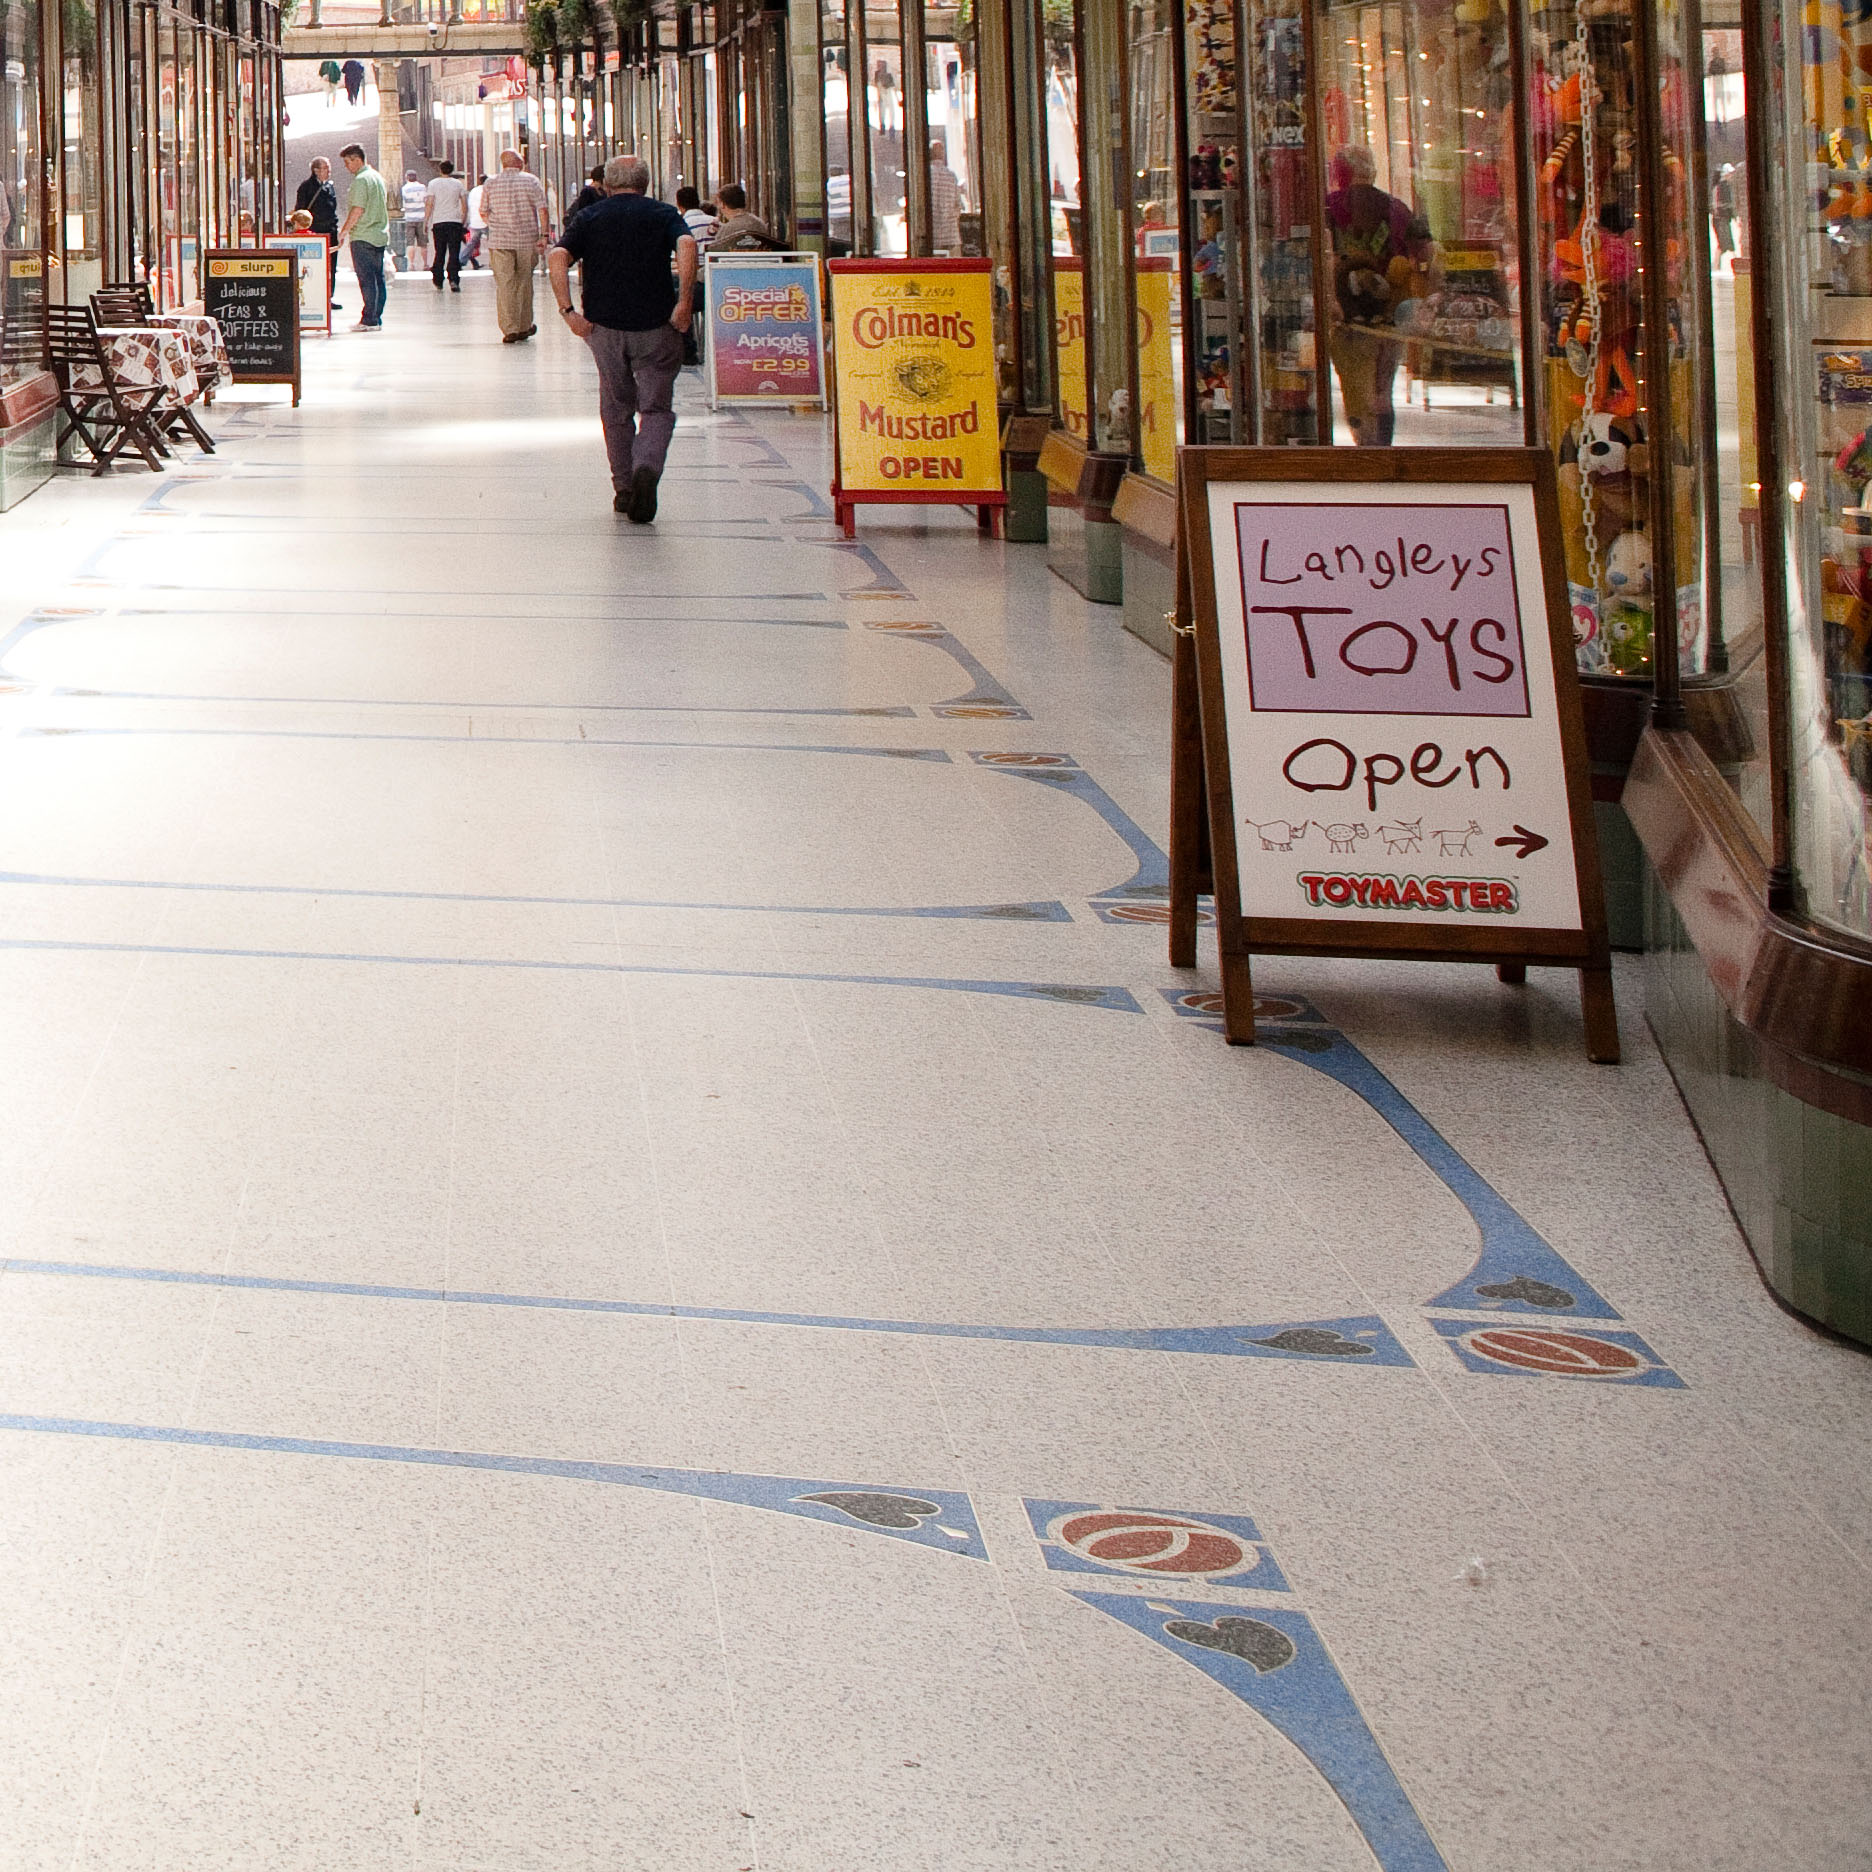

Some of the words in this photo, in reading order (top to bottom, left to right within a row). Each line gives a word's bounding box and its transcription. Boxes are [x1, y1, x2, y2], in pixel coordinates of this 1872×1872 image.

[240, 262, 274, 274] slurp
[220, 282, 267, 297] delicious
[724, 288, 789, 305] Special
[213, 303, 251, 318] TEAS
[720, 304, 808, 321] OFFER
[217, 320, 279, 337] COFFEES
[853, 306, 975, 349] Colman's
[736, 333, 808, 350] Apricots
[752, 358, 809, 371] £2.99
[859, 400, 979, 441] Mustard
[880, 456, 964, 479] OPEN
[1259, 537, 1502, 591] Langleys
[1250, 606, 1515, 692] TOYS
[1282, 738, 1512, 812] Open
[1302, 876, 1516, 911] TOYMASTER
